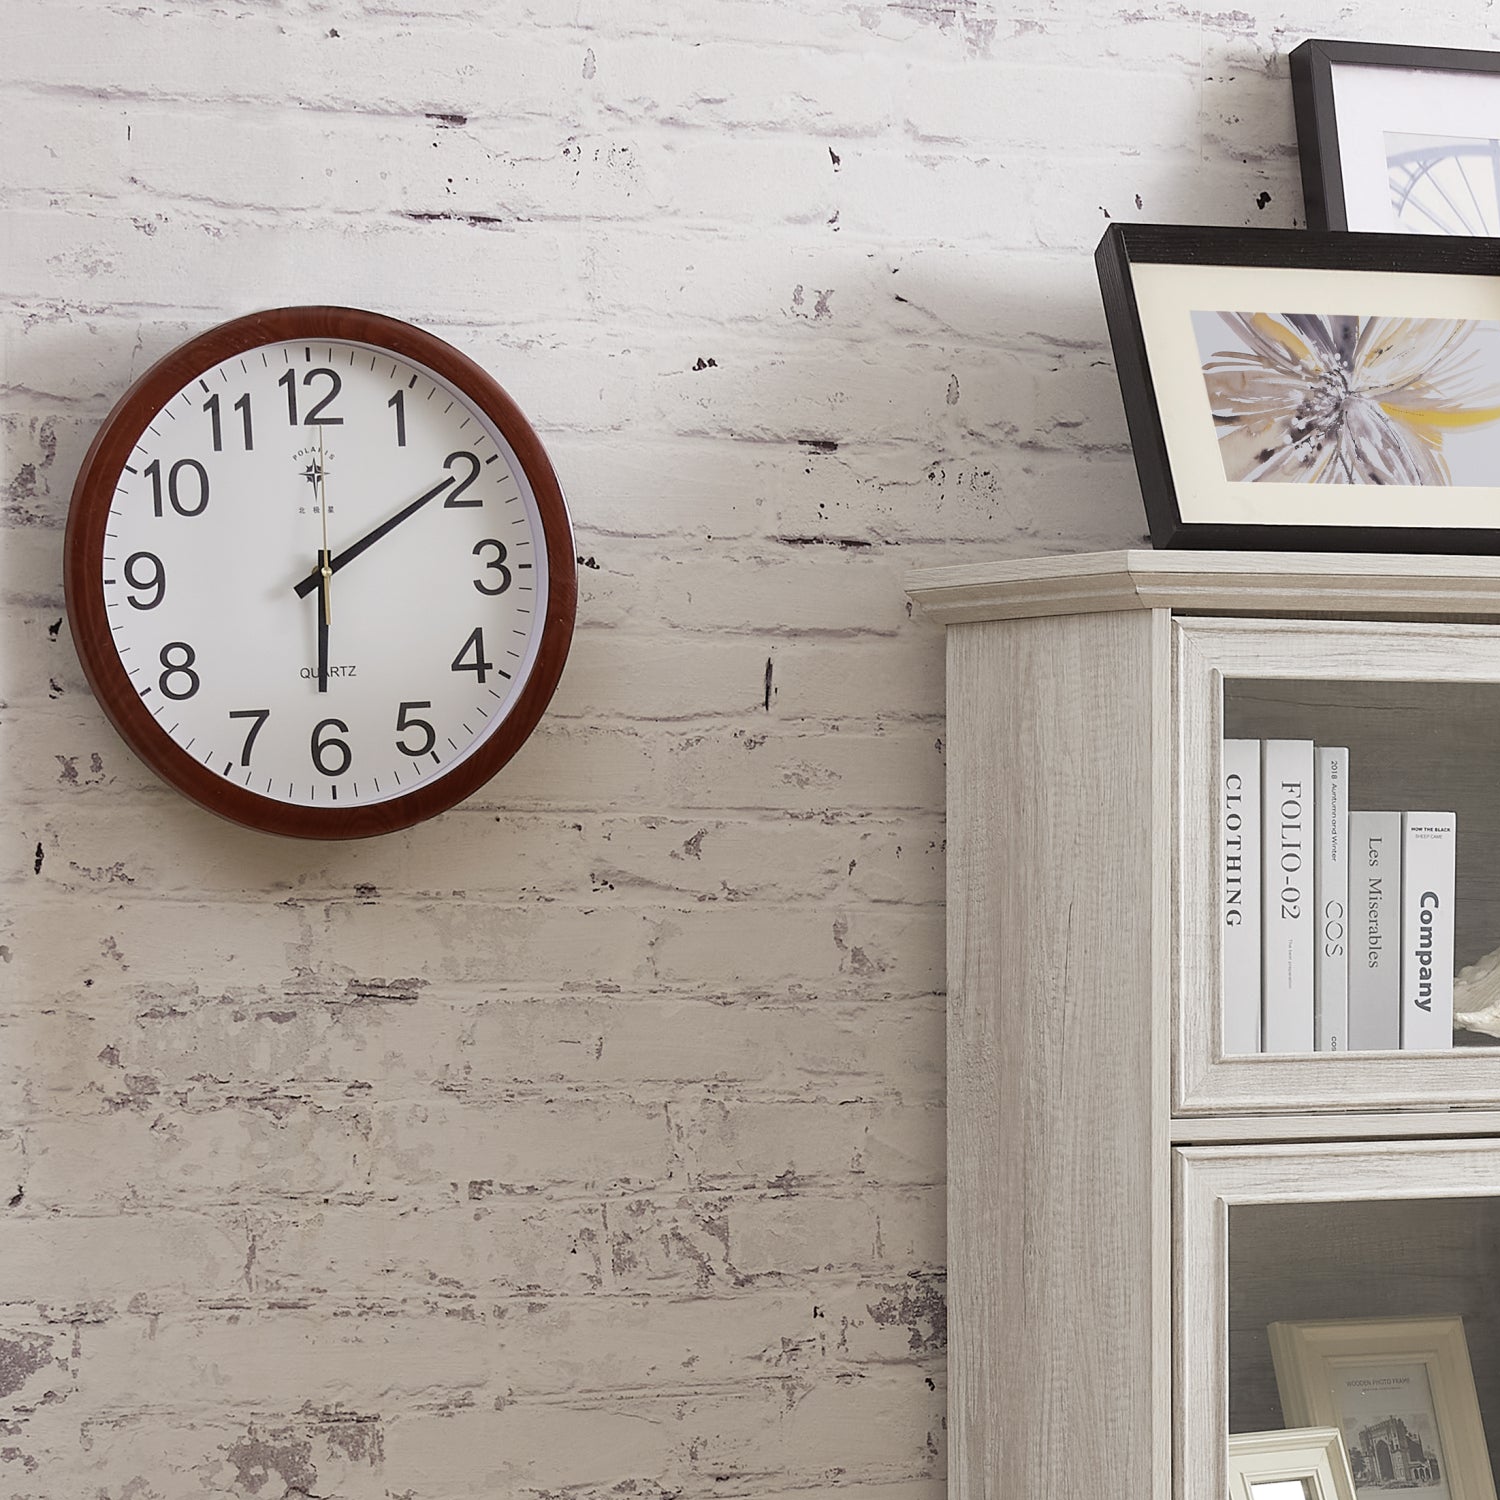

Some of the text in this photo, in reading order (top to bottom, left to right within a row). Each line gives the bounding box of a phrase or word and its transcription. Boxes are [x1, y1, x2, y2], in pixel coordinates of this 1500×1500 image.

[202, 392, 254, 452] 11
[278, 368, 344, 426] 12
[387, 390, 406, 446] 1
[143, 458, 209, 517] 10
[442, 451, 483, 509] 2
[123, 551, 166, 610] 9
[472, 538, 512, 596] 3
[158, 641, 200, 700] 8
[451, 627, 493, 683] 4
[229, 709, 270, 766] 7
[310, 718, 352, 777] 6
[395, 701, 436, 756] 5
[1226, 774, 1242, 926] CLOTHING
[1280, 781, 1302, 919] FOLIO-02
[1325, 900, 1343, 957] COS
[1368, 837, 1382, 969] Les Miserables
[1414, 891, 1439, 1012] Company
